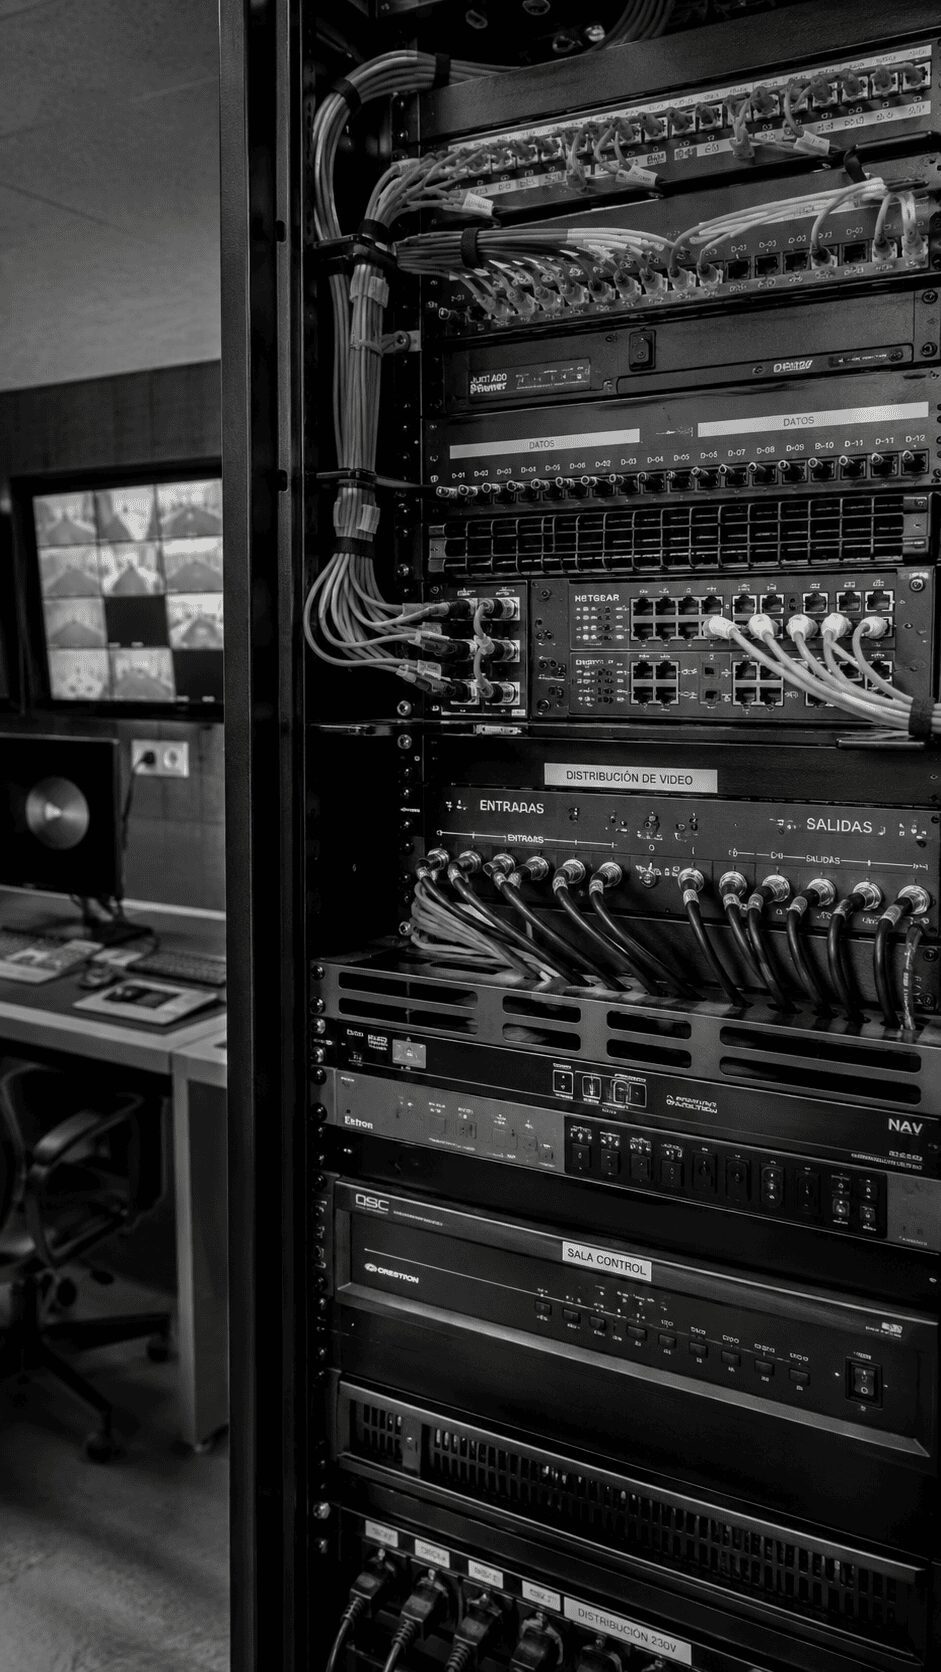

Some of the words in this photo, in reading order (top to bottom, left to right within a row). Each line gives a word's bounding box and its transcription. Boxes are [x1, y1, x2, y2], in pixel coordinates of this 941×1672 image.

[783, 416, 814, 427] DATOS
[529, 439, 555, 450] DATOS
[566, 770, 639, 783] DISTRIBUCIÓN
[642, 774, 656, 784] DE
[660, 774, 693, 786] VIDEO
[806, 817, 873, 834] SALIDAS
[888, 1118, 924, 1136] NAV
[567, 1248, 594, 1262] SALA
[596, 1254, 647, 1276] CONTROL
[578, 1608, 648, 1642] DISTRIBUCIÓN
[651, 1635, 677, 1653] 230V
